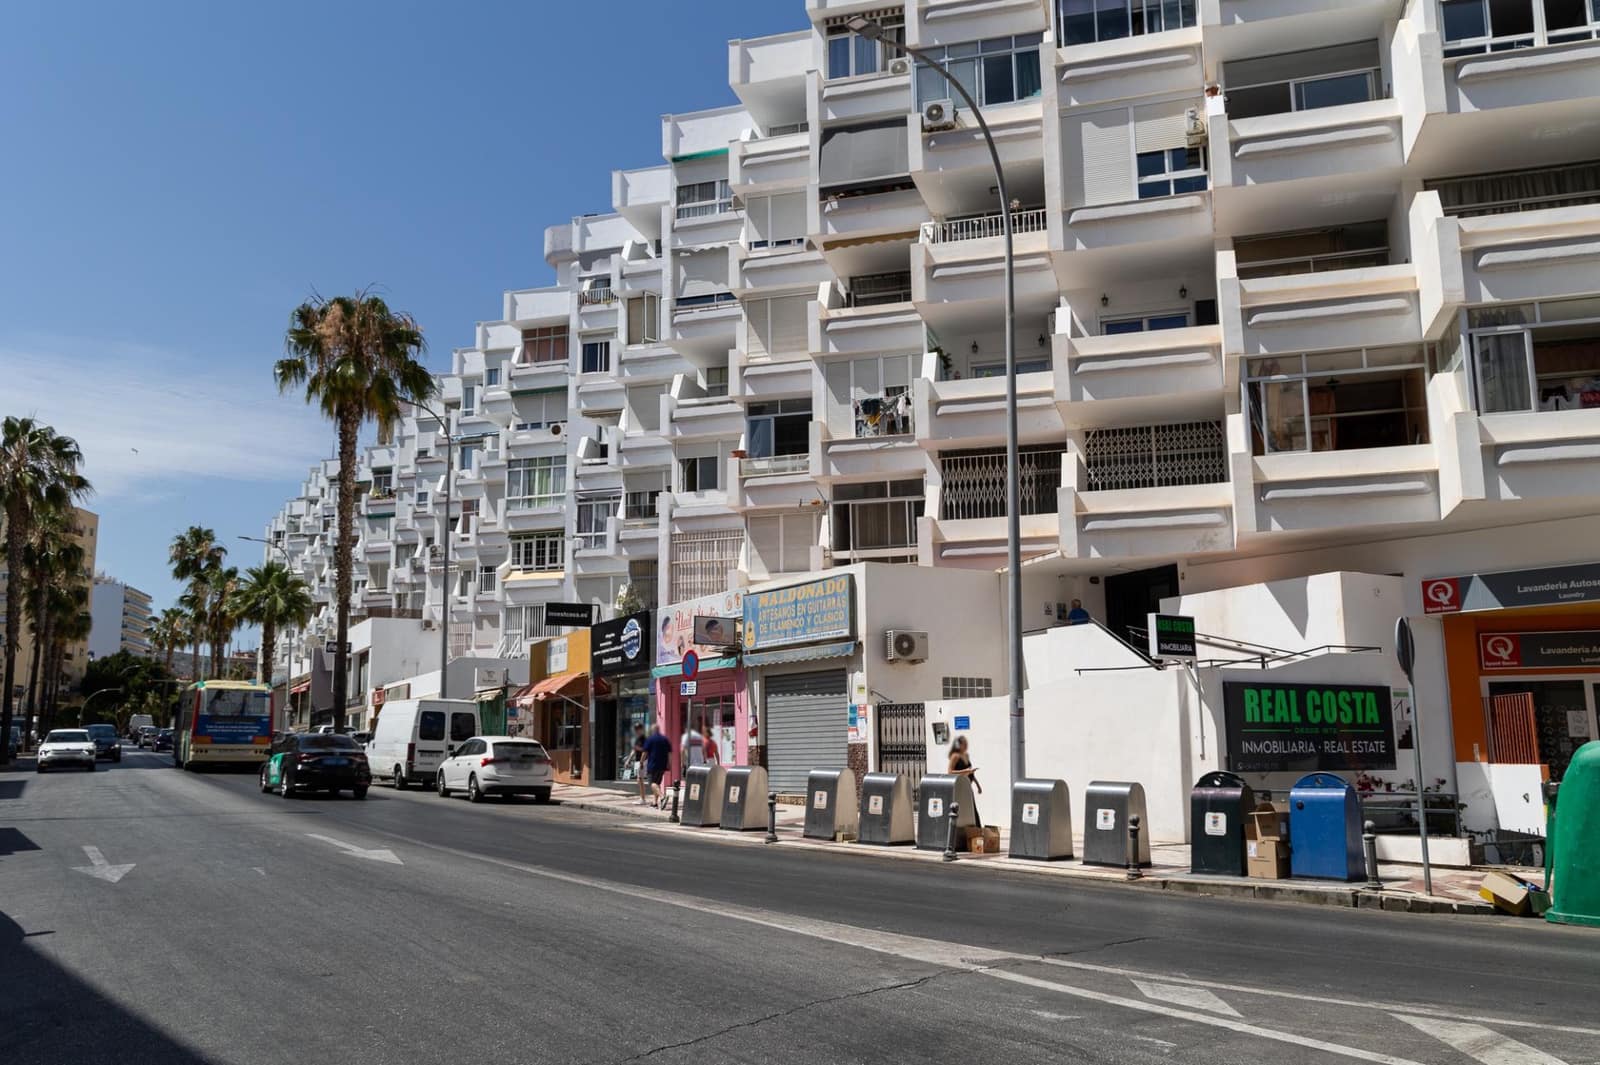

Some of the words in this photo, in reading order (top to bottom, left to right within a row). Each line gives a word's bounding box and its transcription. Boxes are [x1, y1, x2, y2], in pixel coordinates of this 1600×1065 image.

[759, 579, 846, 608] MALDONADO
[759, 605, 796, 621] ARTESANOS
[797, 603, 806, 615] EN
[807, 597, 846, 614] GUITARRAS
[759, 622, 769, 633] DE
[769, 617, 805, 632] FLAMENCO
[1244, 689, 1302, 723] REAL
[1306, 690, 1380, 724] COSTA
[1242, 740, 1316, 754] INMOBILIARIA
[1324, 741, 1350, 753] REAL
[1352, 741, 1386, 753] ESTATE
